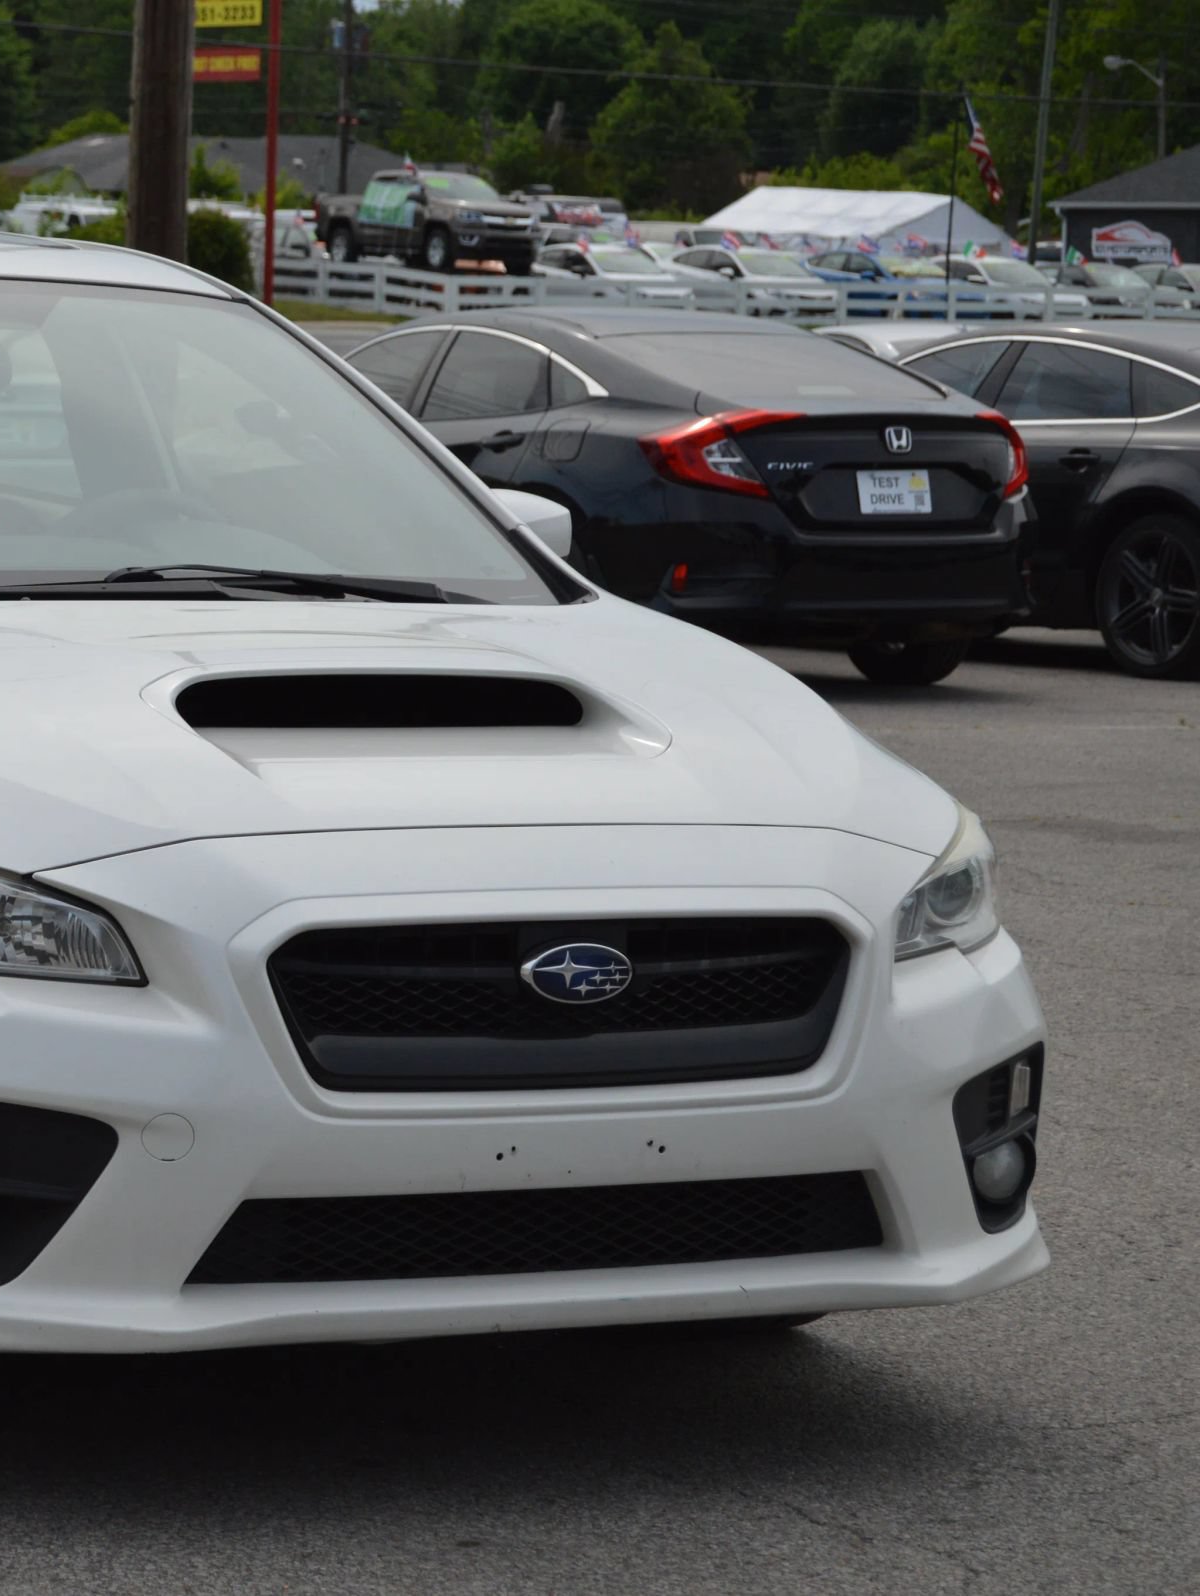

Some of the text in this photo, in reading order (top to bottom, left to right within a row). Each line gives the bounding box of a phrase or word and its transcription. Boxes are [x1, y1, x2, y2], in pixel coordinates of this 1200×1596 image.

[767, 461, 814, 471] CIVIC
[870, 476, 900, 488] TEST
[869, 493, 904, 505] DRIVE
